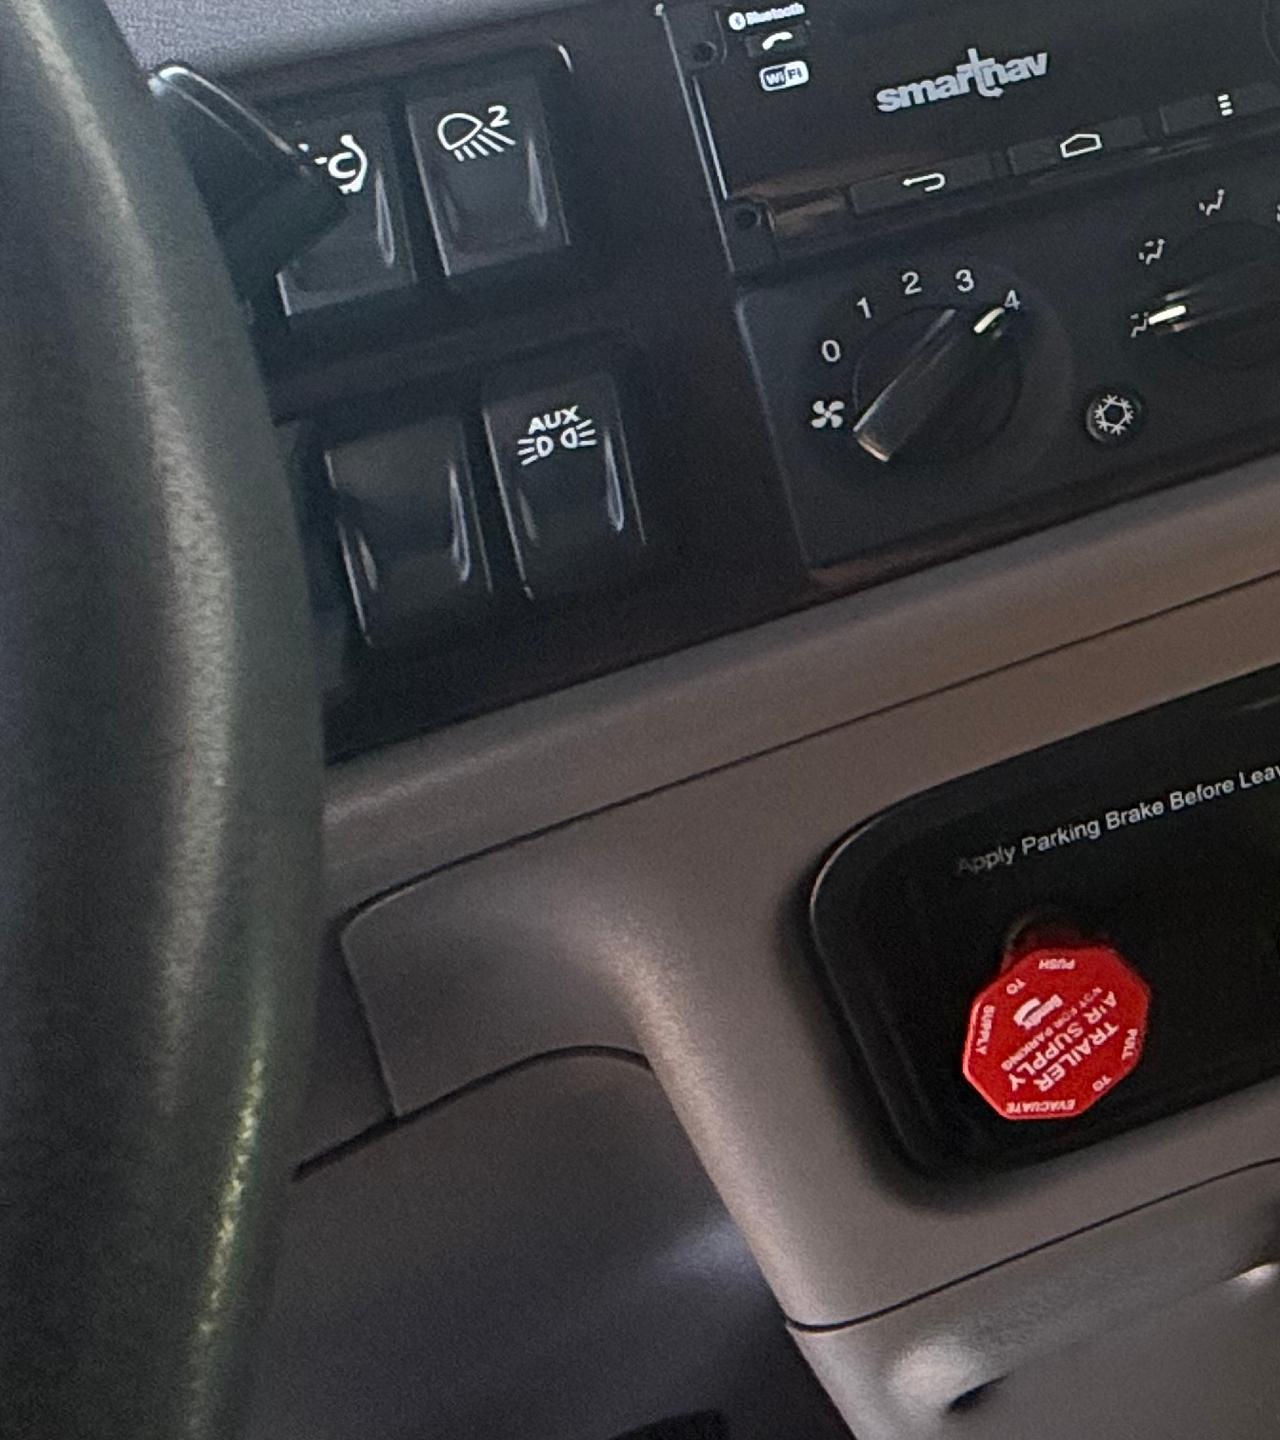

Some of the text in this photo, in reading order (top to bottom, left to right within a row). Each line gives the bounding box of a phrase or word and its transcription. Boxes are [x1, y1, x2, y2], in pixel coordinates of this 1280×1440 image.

[876, 47, 1049, 113] smartnav
[486, 105, 511, 129] 2
[901, 271, 923, 296] 2
[955, 268, 976, 295] 3
[856, 296, 873, 320] 1
[1003, 288, 1021, 312] 4
[820, 339, 842, 363] 0
[527, 405, 582, 434] AUX
[956, 844, 1017, 877] Apply
[1021, 816, 1102, 856] Parking
[1105, 797, 1165, 831] Brake
[1169, 777, 1235, 811] Before
[1005, 977, 1027, 996] TO
[1000, 1026, 1055, 1072] PARKING
[1008, 990, 1118, 1092] AIR SUPPLY
[1033, 1021, 1120, 1093] TRAILER
[1092, 1074, 1113, 1093] TO
